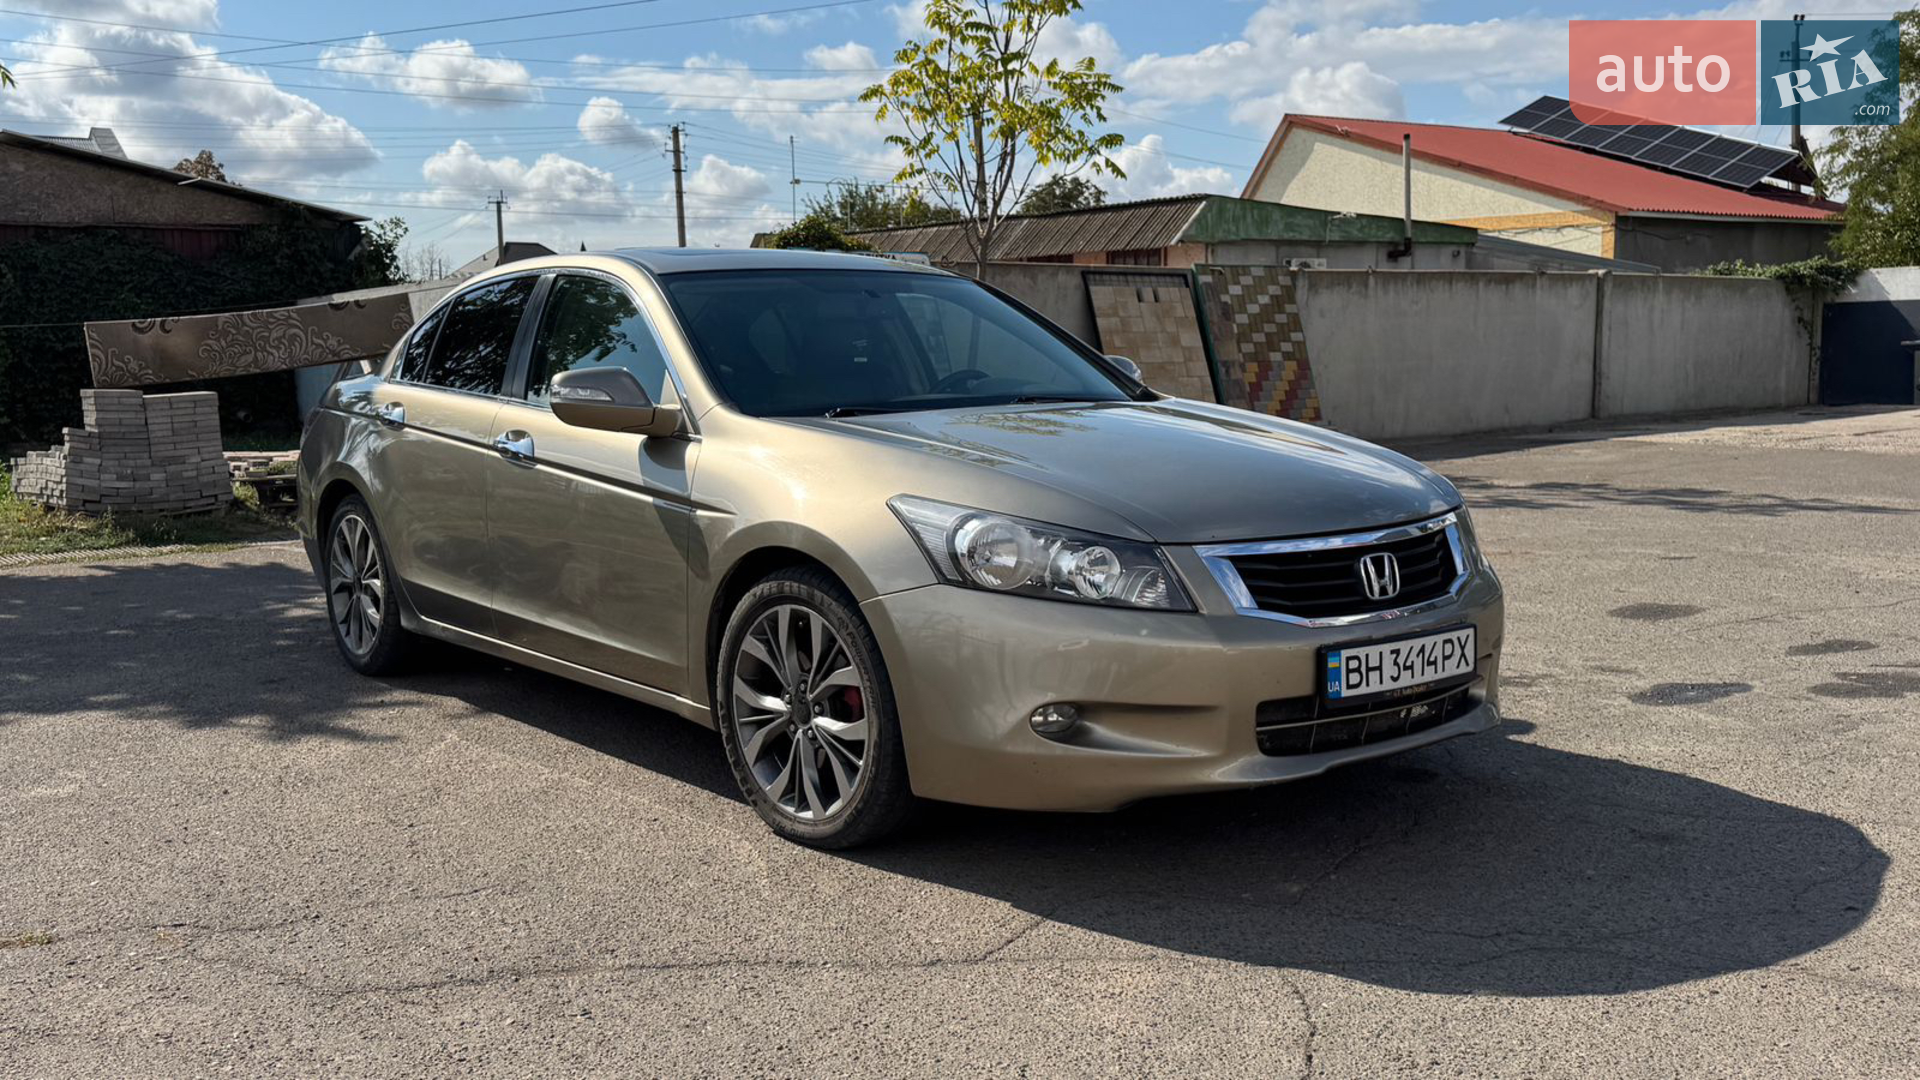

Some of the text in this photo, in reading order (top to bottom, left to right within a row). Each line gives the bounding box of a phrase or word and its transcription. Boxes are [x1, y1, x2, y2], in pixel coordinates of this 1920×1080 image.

[1345, 634, 1470, 690] BH 3414 PX
[1327, 681, 1340, 692] UA
